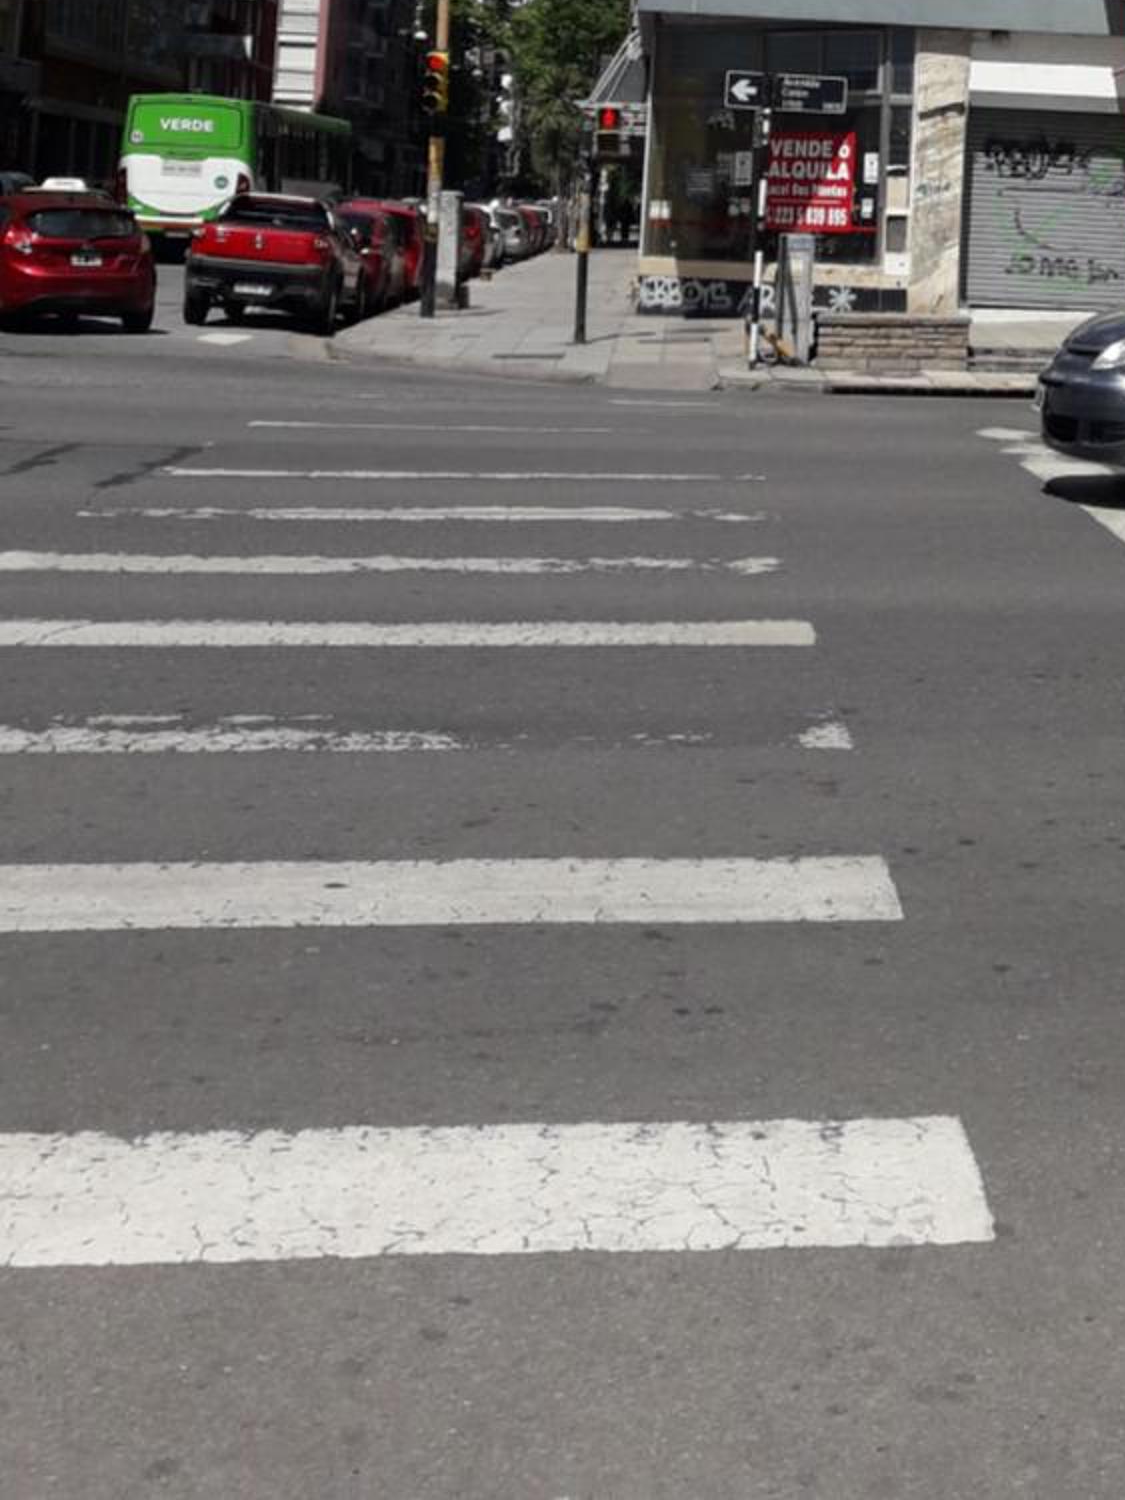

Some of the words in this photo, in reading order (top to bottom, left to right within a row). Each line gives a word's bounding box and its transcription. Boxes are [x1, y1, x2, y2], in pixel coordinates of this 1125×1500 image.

[160, 117, 214, 133] VERDE
[770, 139, 834, 159] VENDE
[769, 161, 850, 181] ALQUILA
